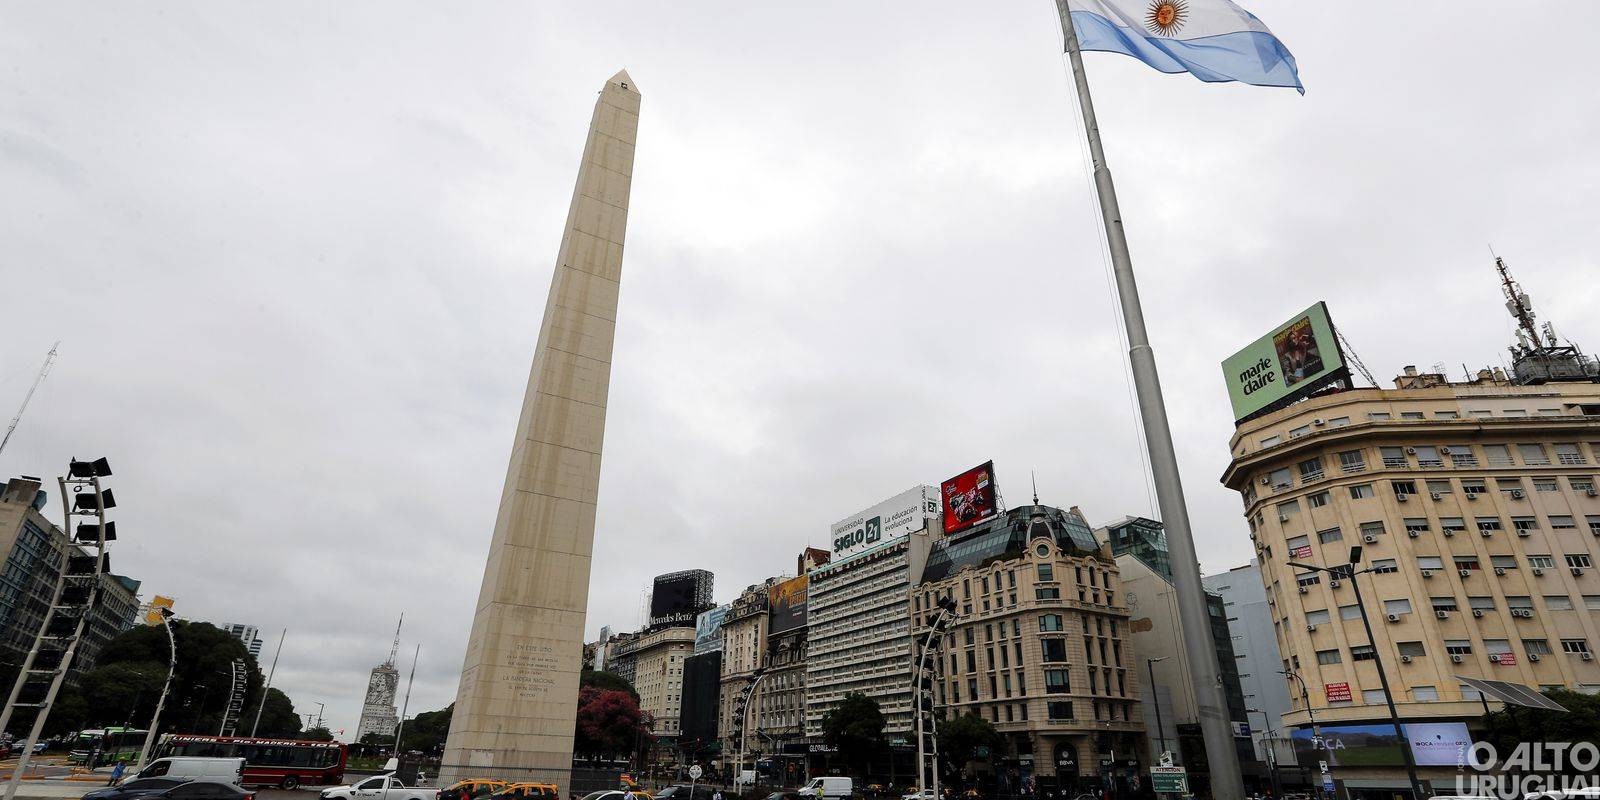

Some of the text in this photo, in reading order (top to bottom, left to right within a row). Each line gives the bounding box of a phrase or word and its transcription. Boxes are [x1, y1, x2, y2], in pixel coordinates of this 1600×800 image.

[1239, 358, 1273, 383] marie
[1243, 371, 1276, 395] claire
[834, 517, 864, 536] UNIVERSIDAD
[884, 515, 893, 524] La
[884, 516, 913, 532] evoluciona
[833, 522, 880, 553] SIGLO 21
